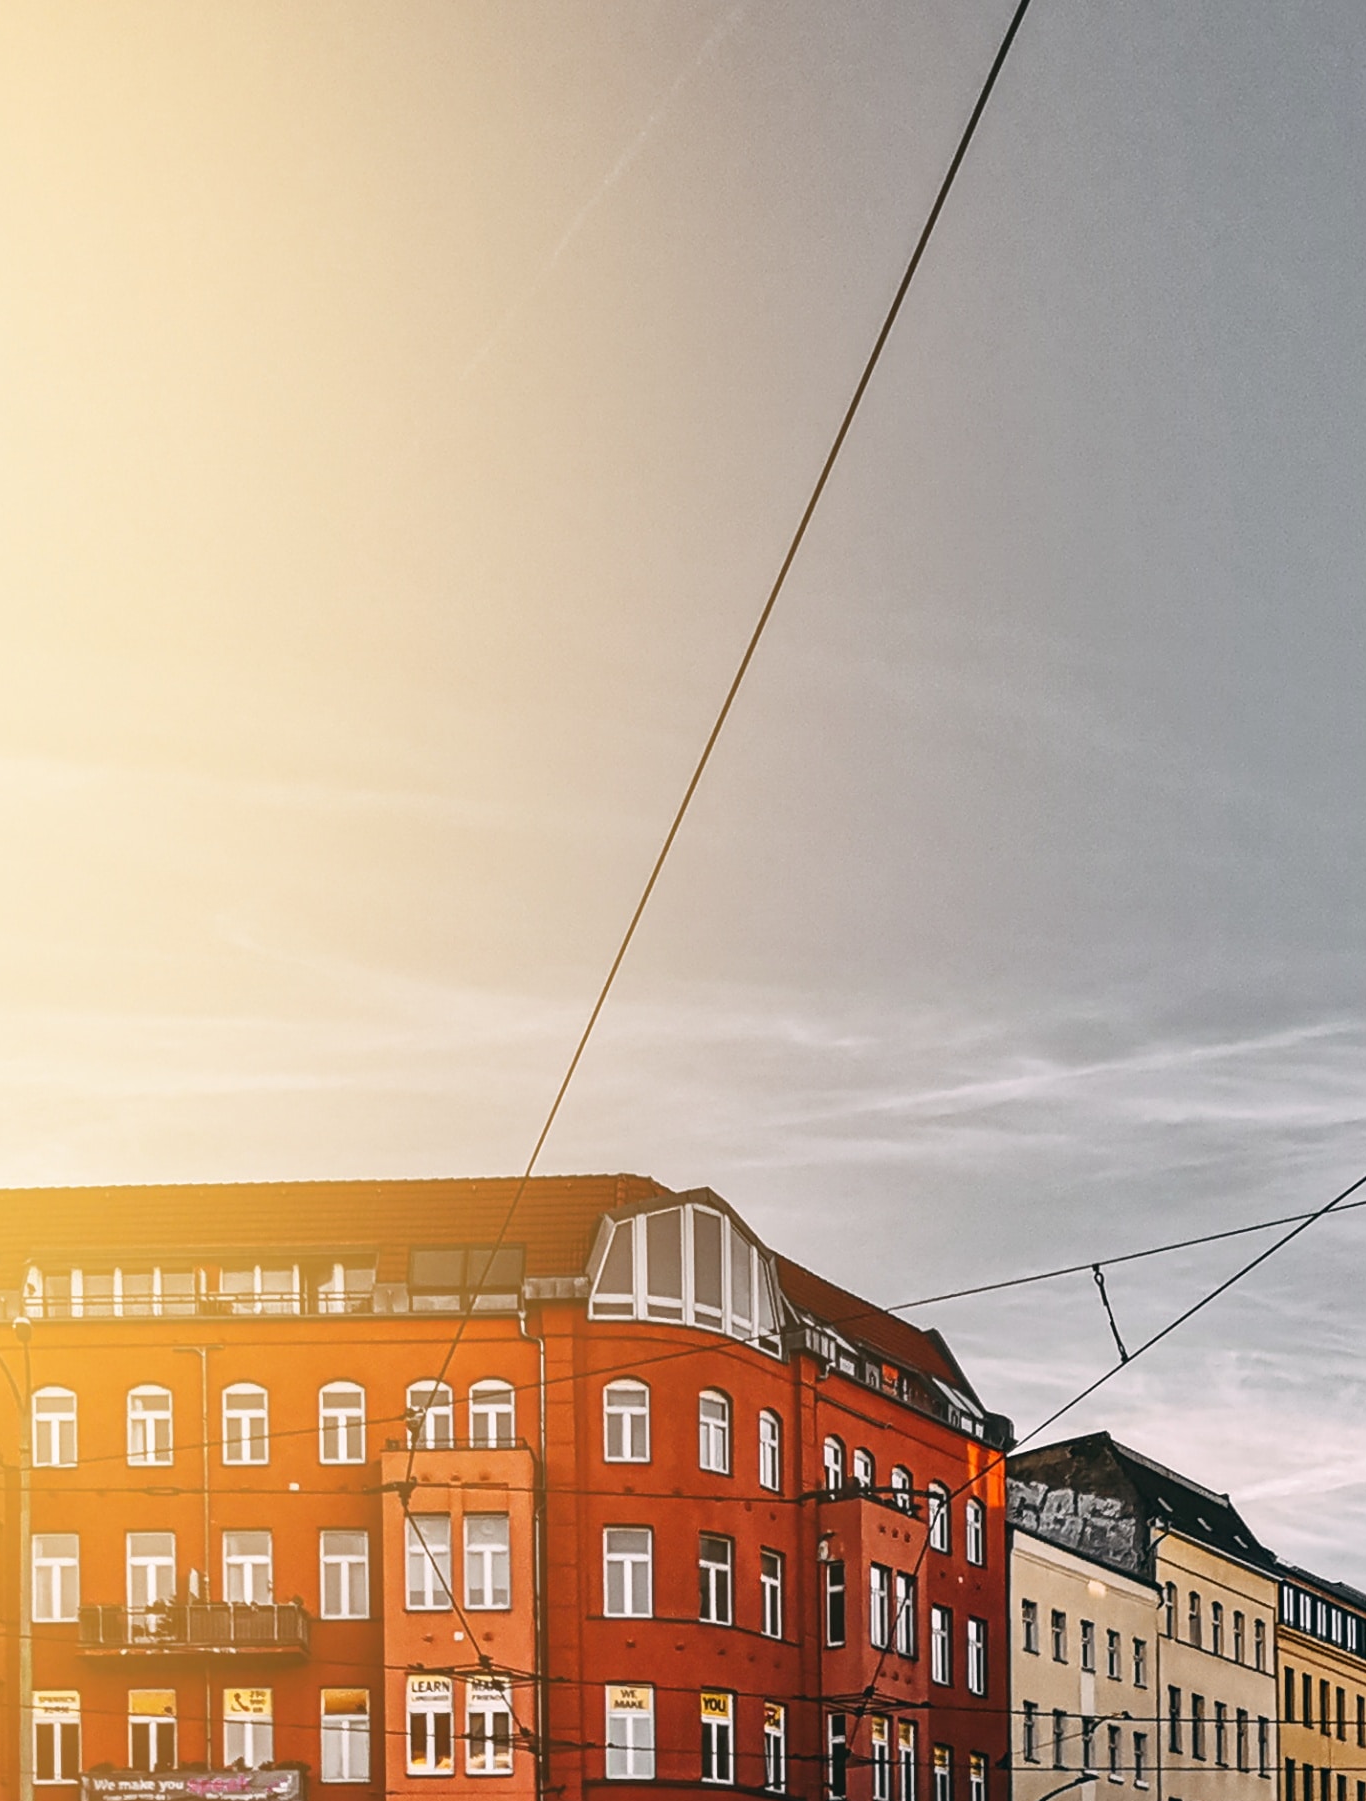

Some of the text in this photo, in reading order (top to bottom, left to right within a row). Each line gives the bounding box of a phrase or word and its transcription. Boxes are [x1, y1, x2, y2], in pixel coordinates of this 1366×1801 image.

[411, 1681, 450, 1692] LEARN
[620, 1690, 637, 1699] WE
[703, 1697, 726, 1713] YOU
[93, 1778, 115, 1791] We
[118, 1777, 155, 1791] make
[158, 1780, 184, 1793] you
